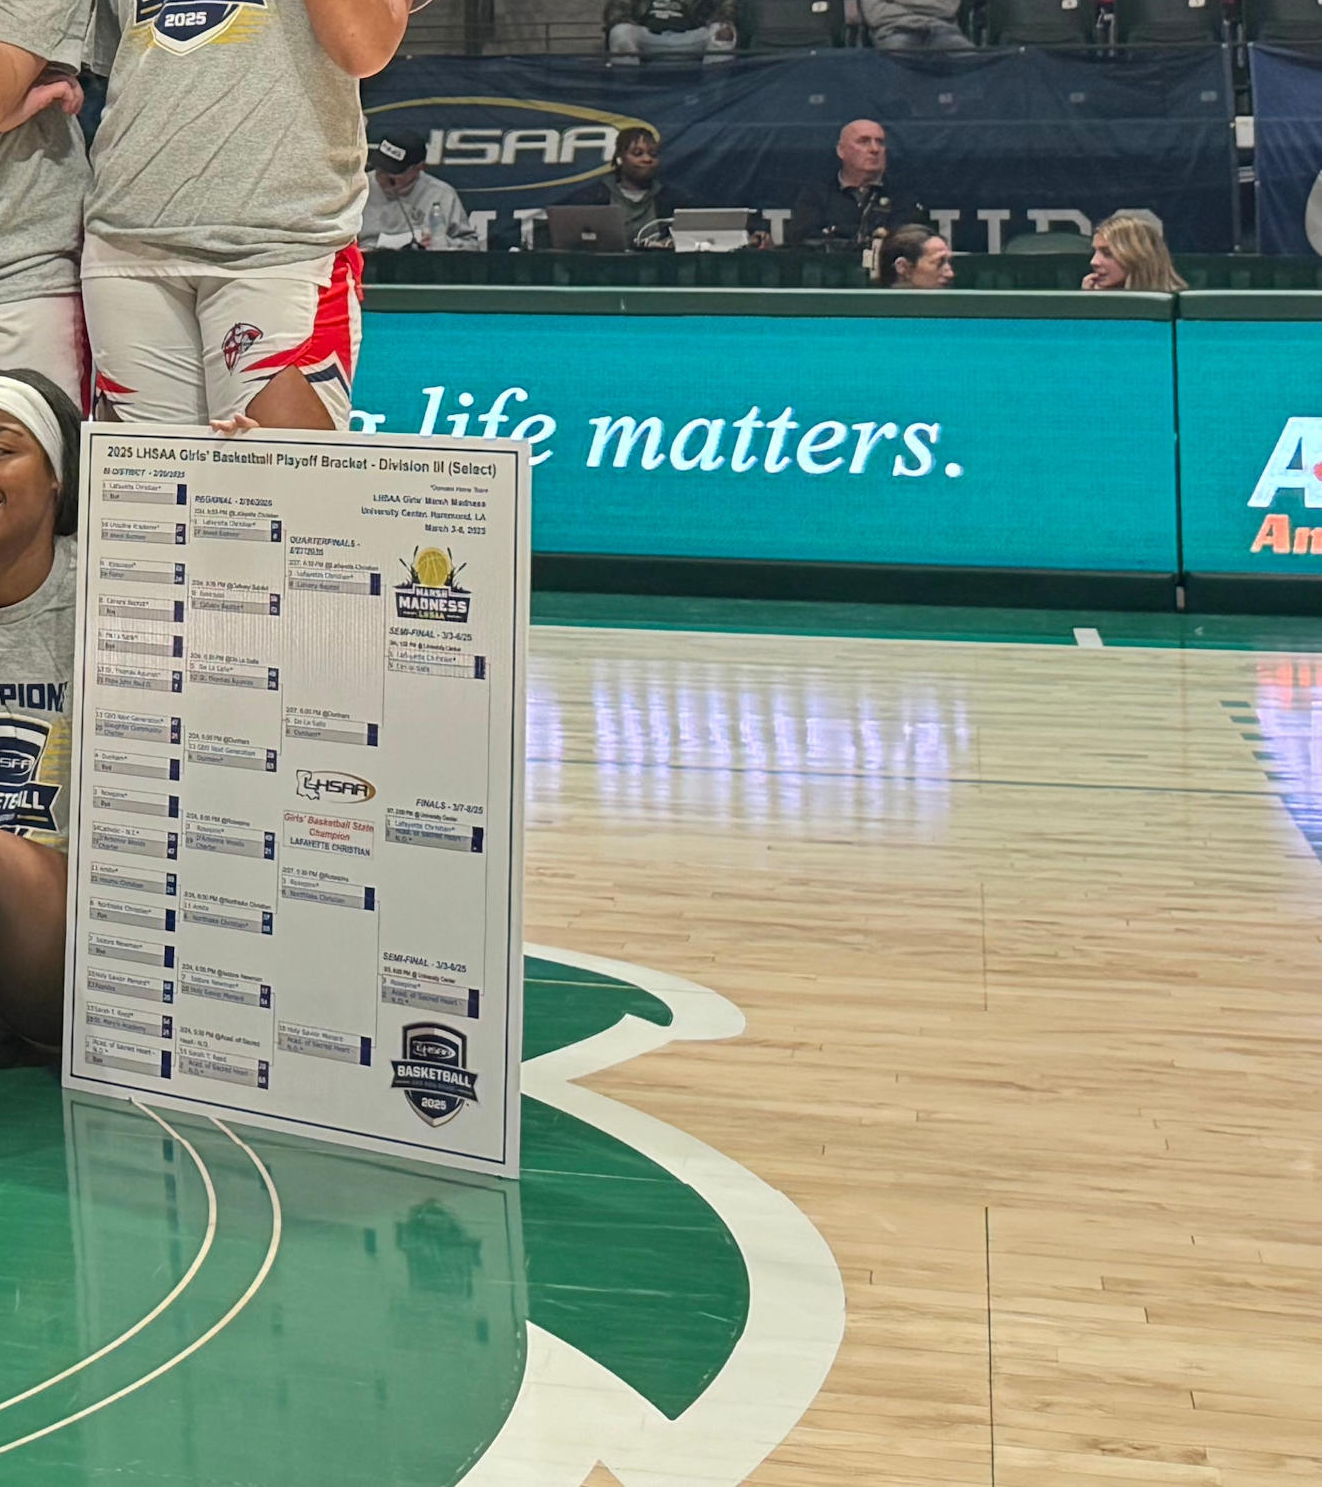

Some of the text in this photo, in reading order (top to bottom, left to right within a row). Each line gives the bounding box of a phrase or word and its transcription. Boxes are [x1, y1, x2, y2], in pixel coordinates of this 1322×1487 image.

[164, 12, 207, 29] 2025
[419, 386, 558, 466] life
[587, 401, 964, 479] matters.
[107, 446, 498, 479] 2025 LHSAA Girls' Basketball Playoff Bracket Division III (Select)
[373, 493, 401, 504] LHSAA
[451, 498, 487, 508] Madness
[361, 506, 400, 519] University
[474, 512, 487, 522] LA
[424, 523, 449, 534] March
[289, 535, 355, 548] QUARTERFINALS
[415, 587, 451, 598] MARSH
[398, 595, 468, 614] MADNESS
[303, 776, 369, 797] LHSAA
[415, 798, 446, 810] FINALS
[284, 812, 375, 833] Girls' Basketball State
[309, 828, 351, 843] Champion
[290, 836, 371, 857] LAFAYETTE CHRISTIAN
[383, 951, 429, 967] SEMI-FINAL
[397, 1064, 472, 1087] BASKETBALL
[420, 1096, 448, 1111] 2025
